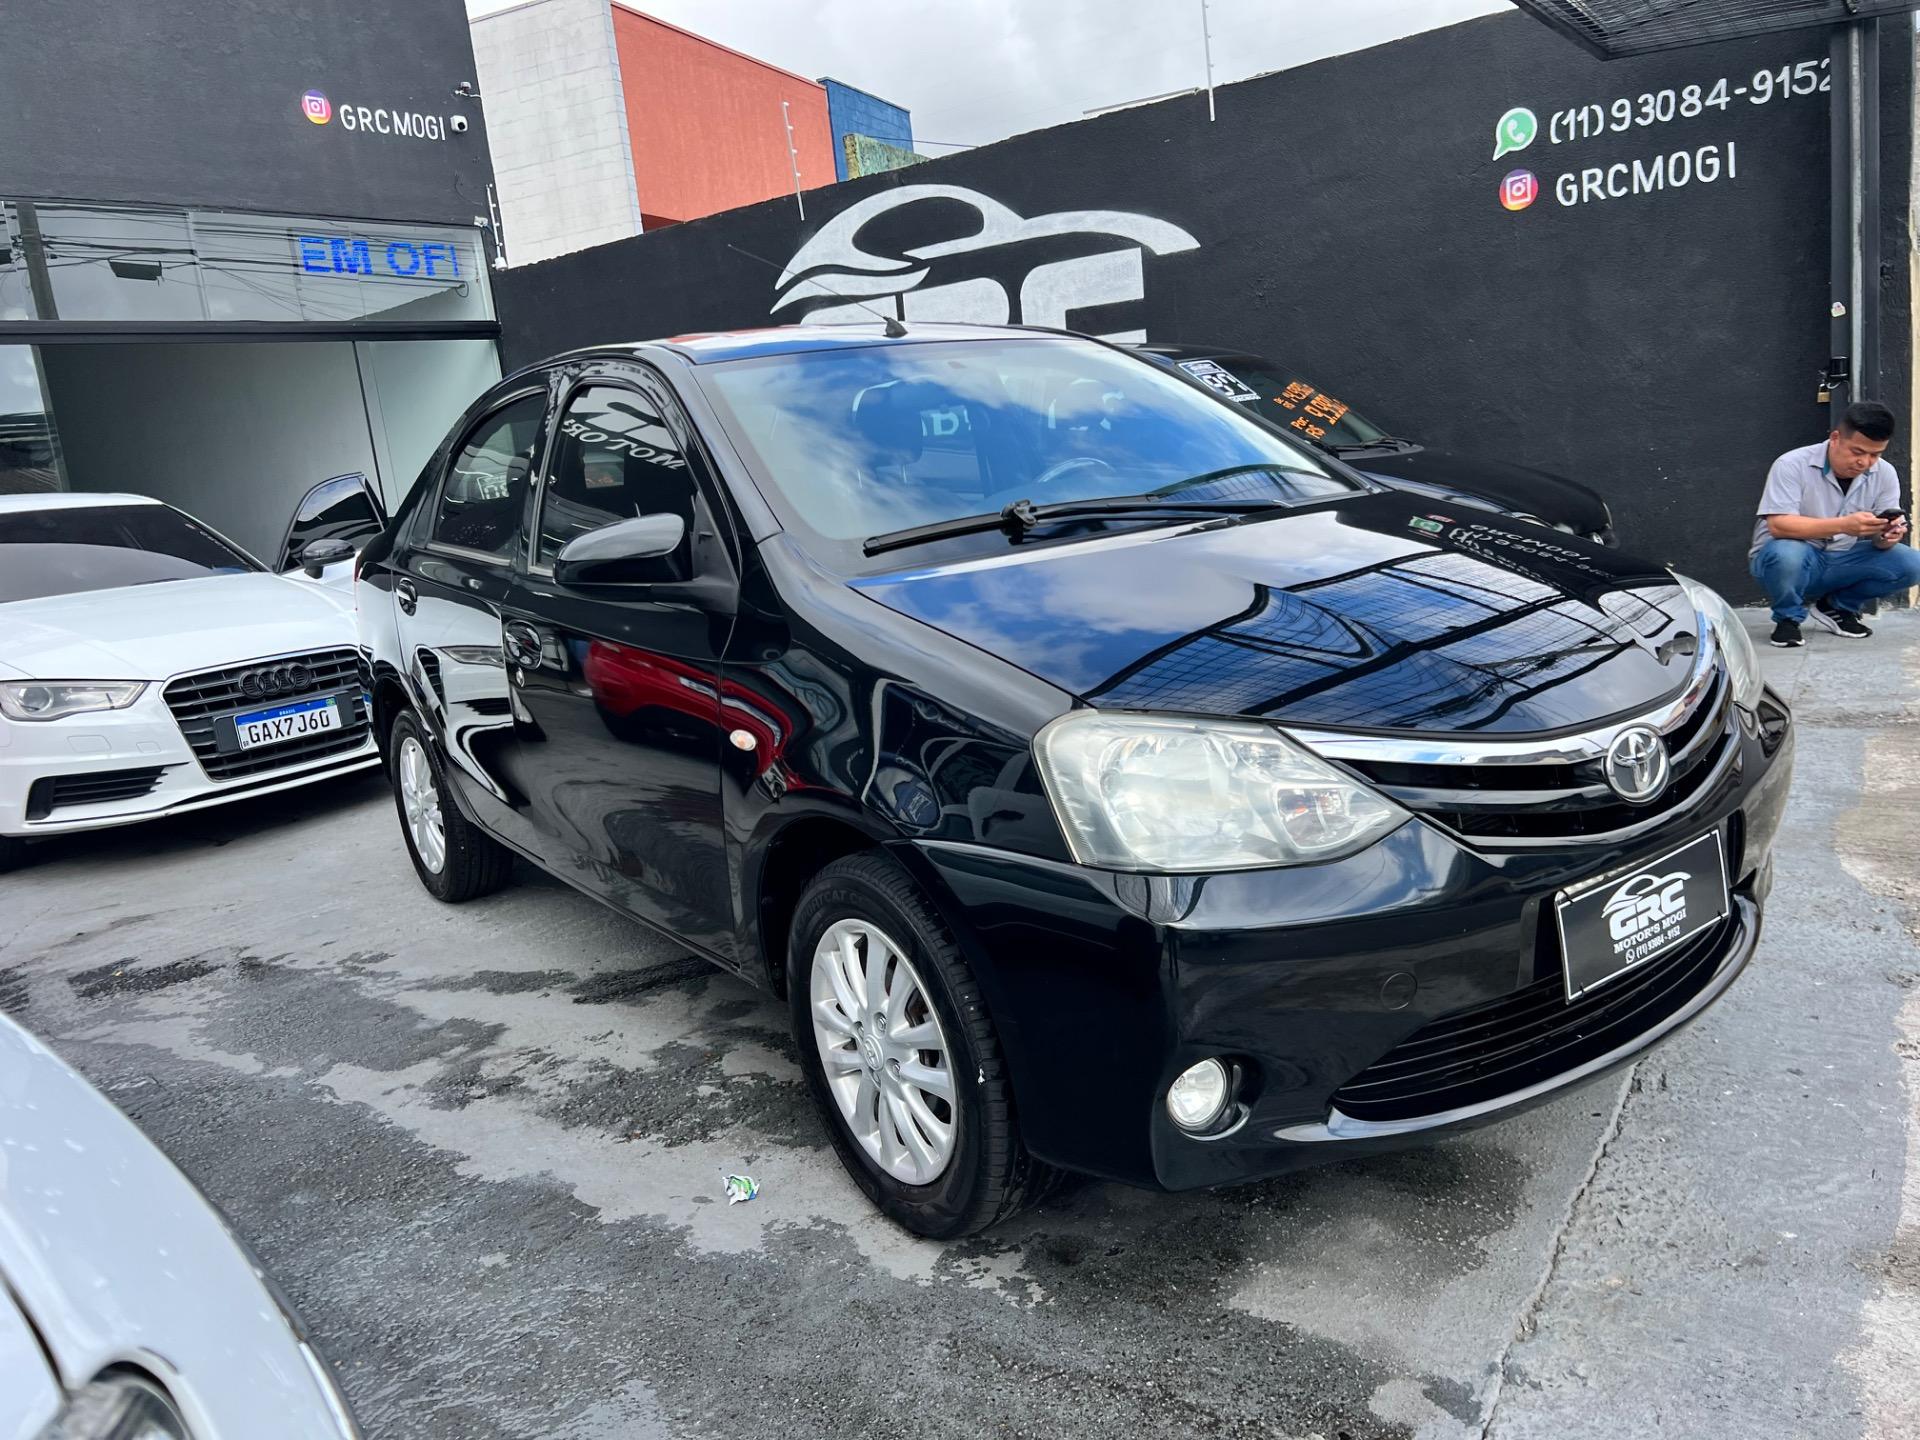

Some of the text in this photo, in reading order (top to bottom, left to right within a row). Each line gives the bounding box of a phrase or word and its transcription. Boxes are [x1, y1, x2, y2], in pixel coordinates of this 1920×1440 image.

[340, 104, 446, 141] GRCMOGI
[1555, 141, 1737, 207] GRCMOGI
[299, 237, 373, 275] EM
[1609, 879, 1686, 941] GRC
[1613, 907, 1687, 954] MOTOR'S MOGI
